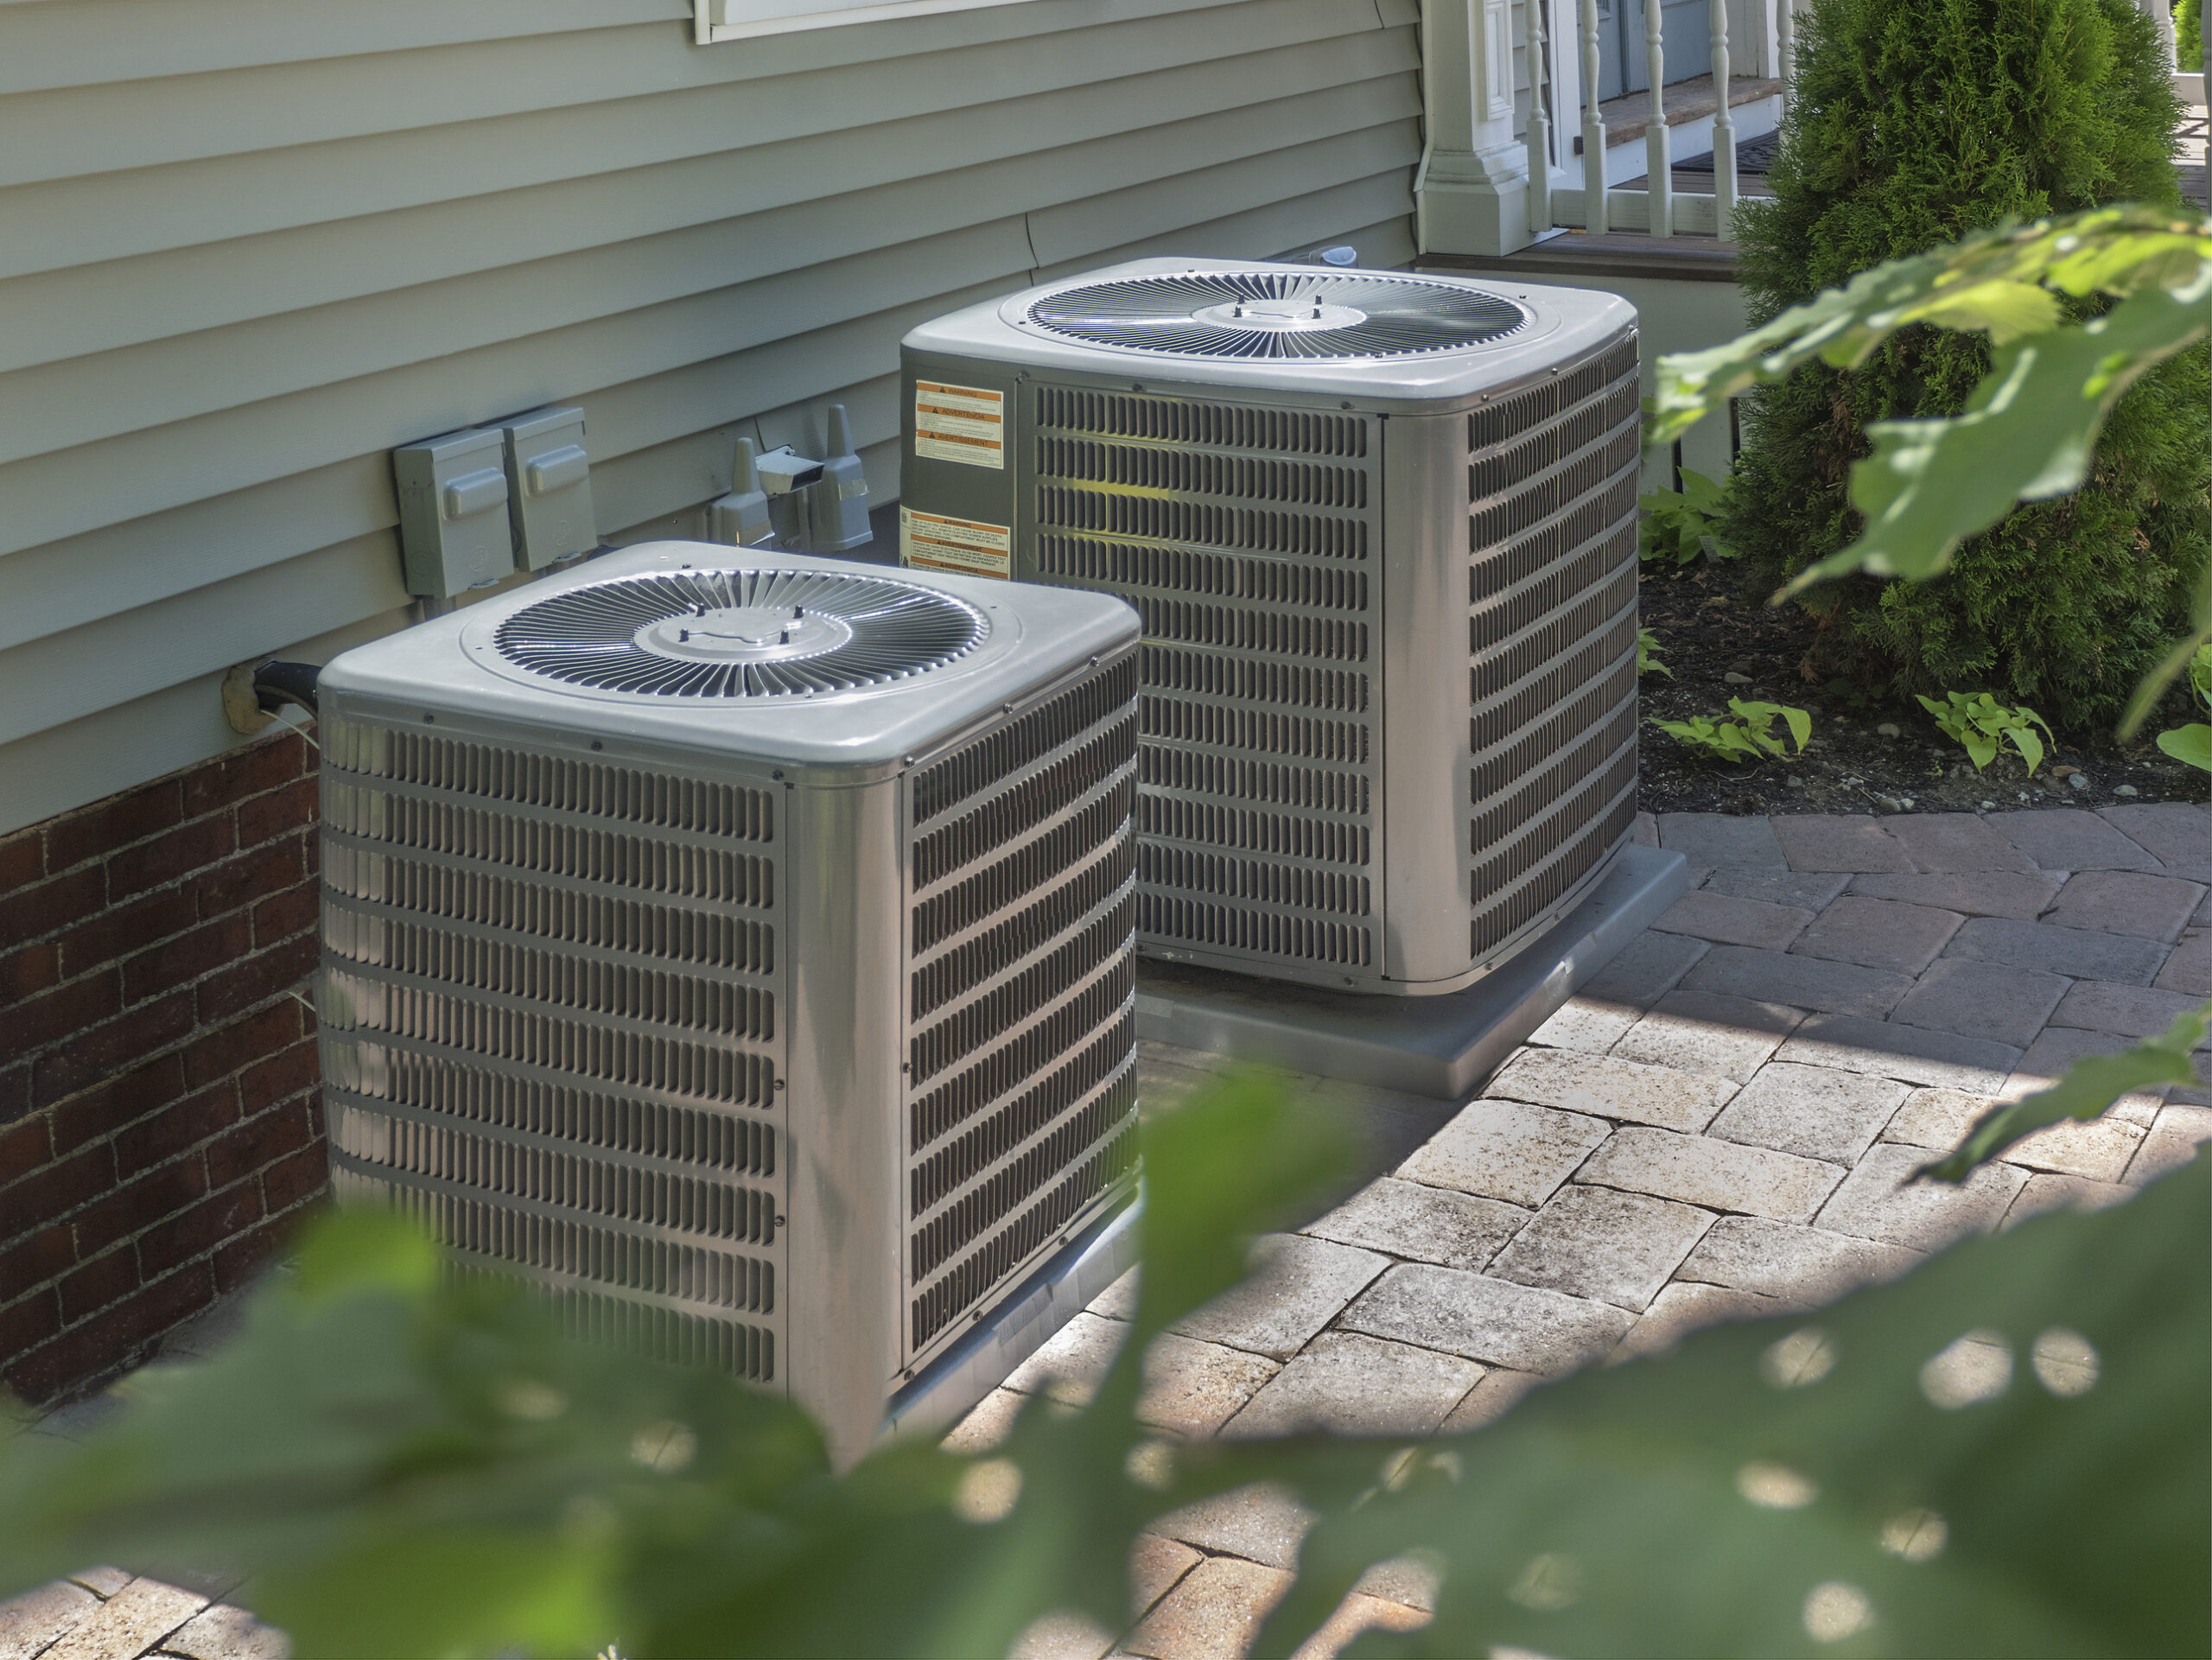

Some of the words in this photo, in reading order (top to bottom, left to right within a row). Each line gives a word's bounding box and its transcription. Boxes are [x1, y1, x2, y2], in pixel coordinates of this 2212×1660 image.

[948, 388, 977, 397] WARNING
[942, 408, 985, 420] ADVERTENCIA
[938, 434, 988, 446] AVERTISSEMENT
[941, 541, 982, 551] AVERTISSEMENT
[944, 562, 979, 573] ADVERTENCIA
